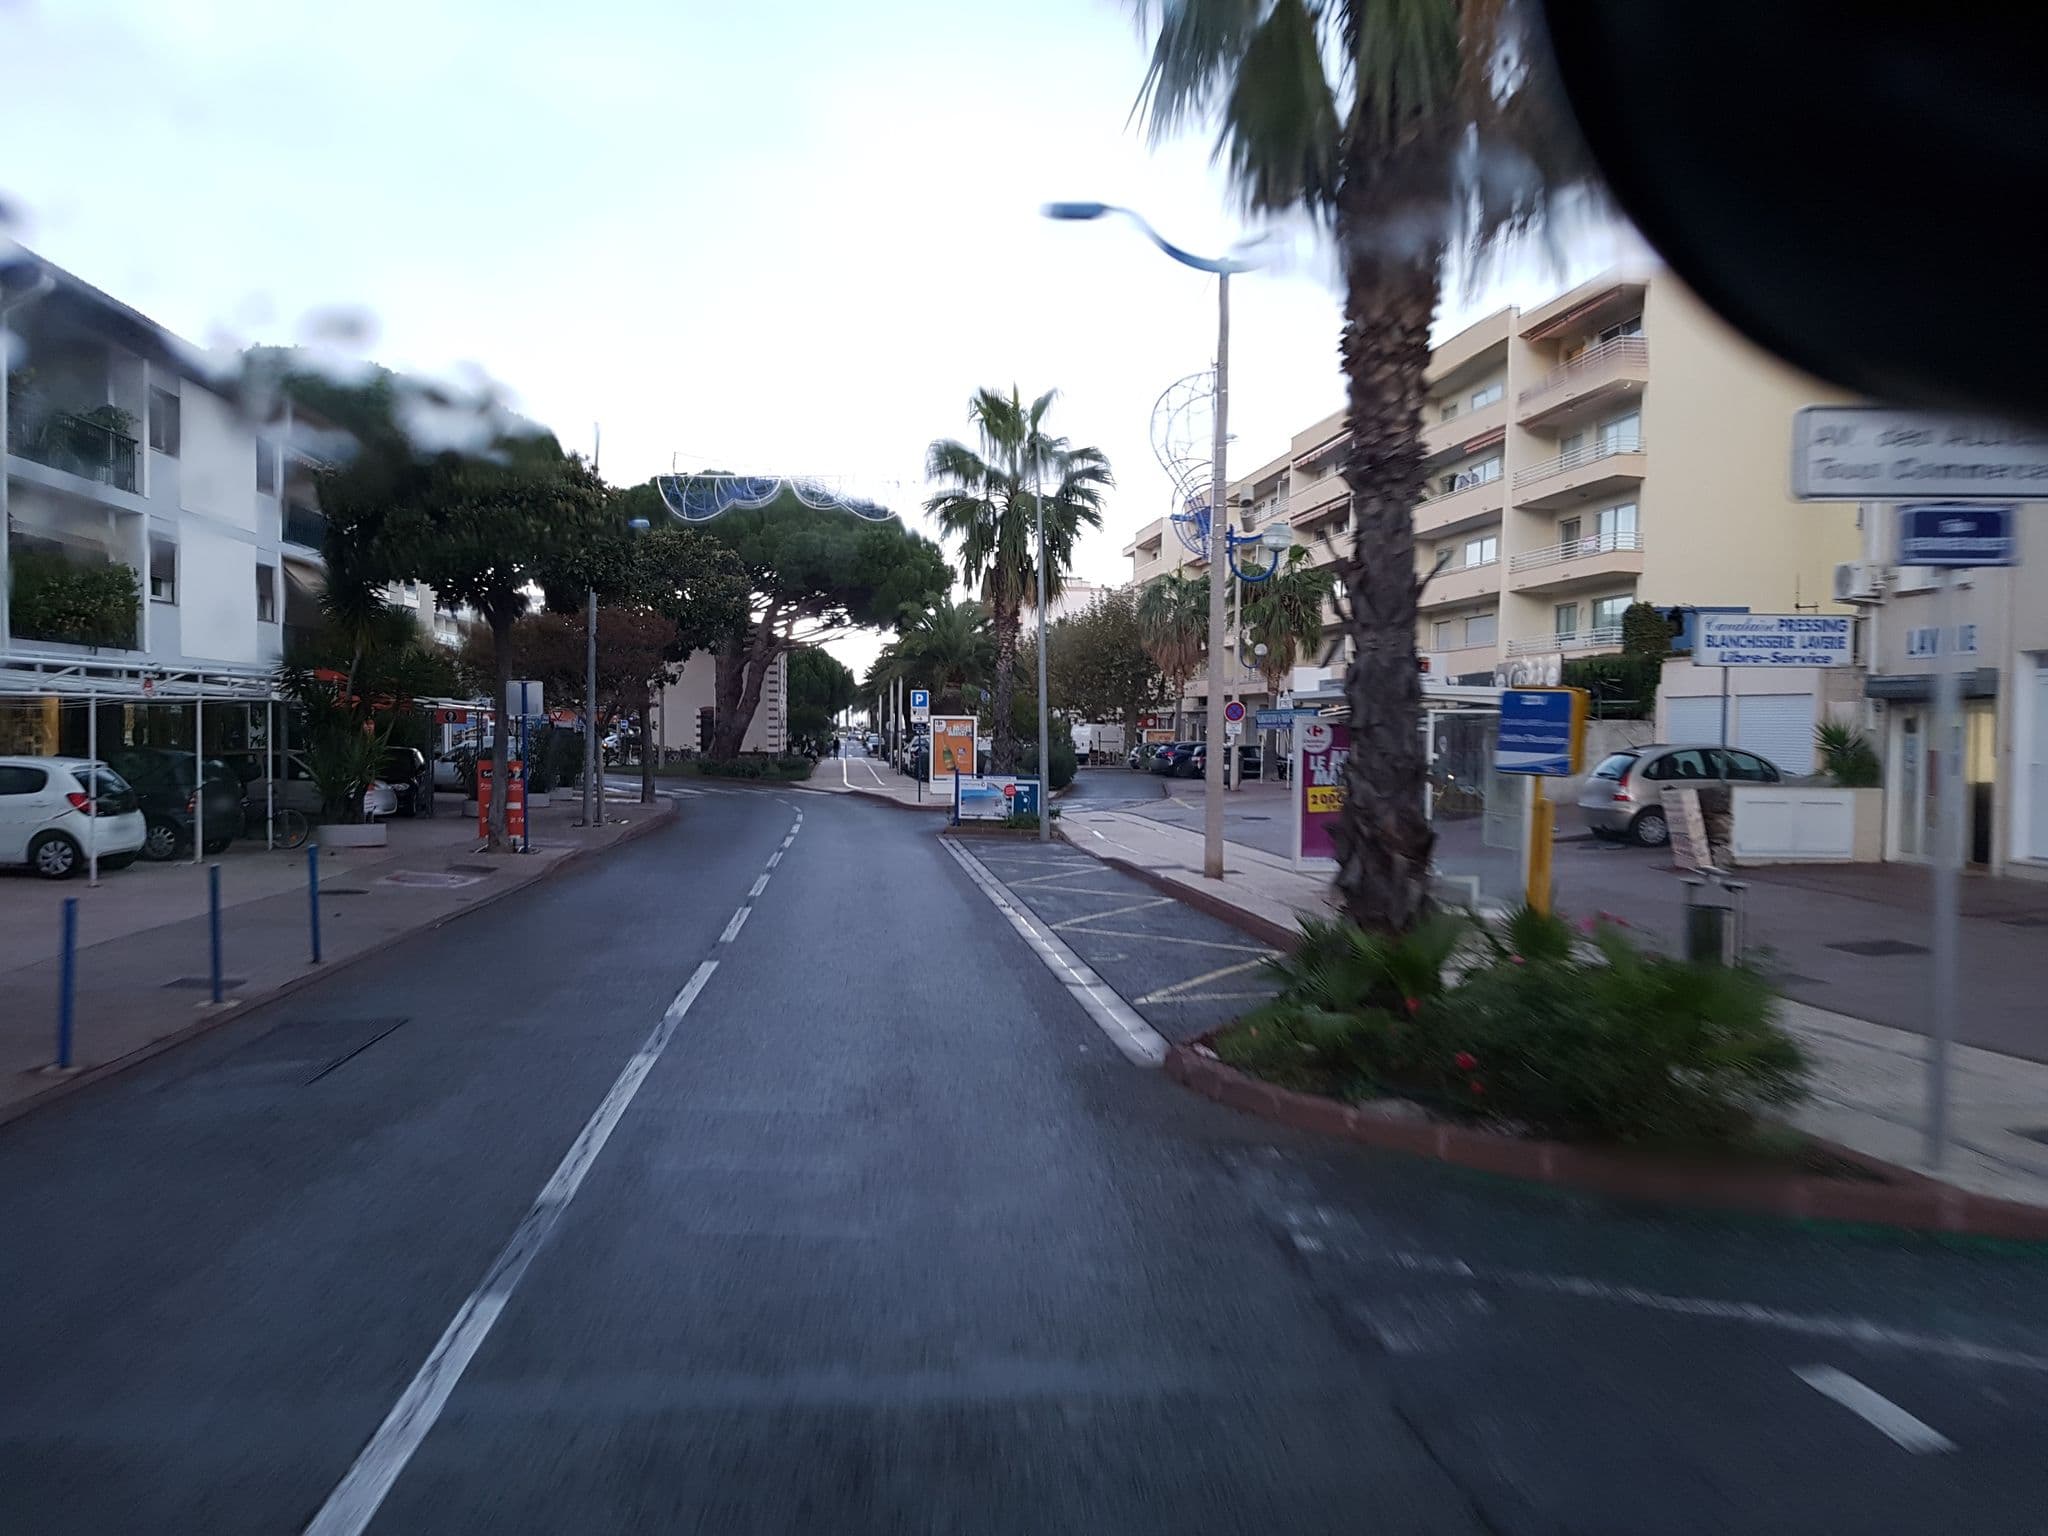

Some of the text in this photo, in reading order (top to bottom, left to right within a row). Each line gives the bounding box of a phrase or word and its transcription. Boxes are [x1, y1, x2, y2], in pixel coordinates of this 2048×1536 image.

[1778, 619, 1848, 632] PRESSING
[1705, 634, 1847, 650] BLANCHISSERIE LAVERIE
[1718, 651, 1833, 664] Libre-Service
[915, 693, 924, 705] P
